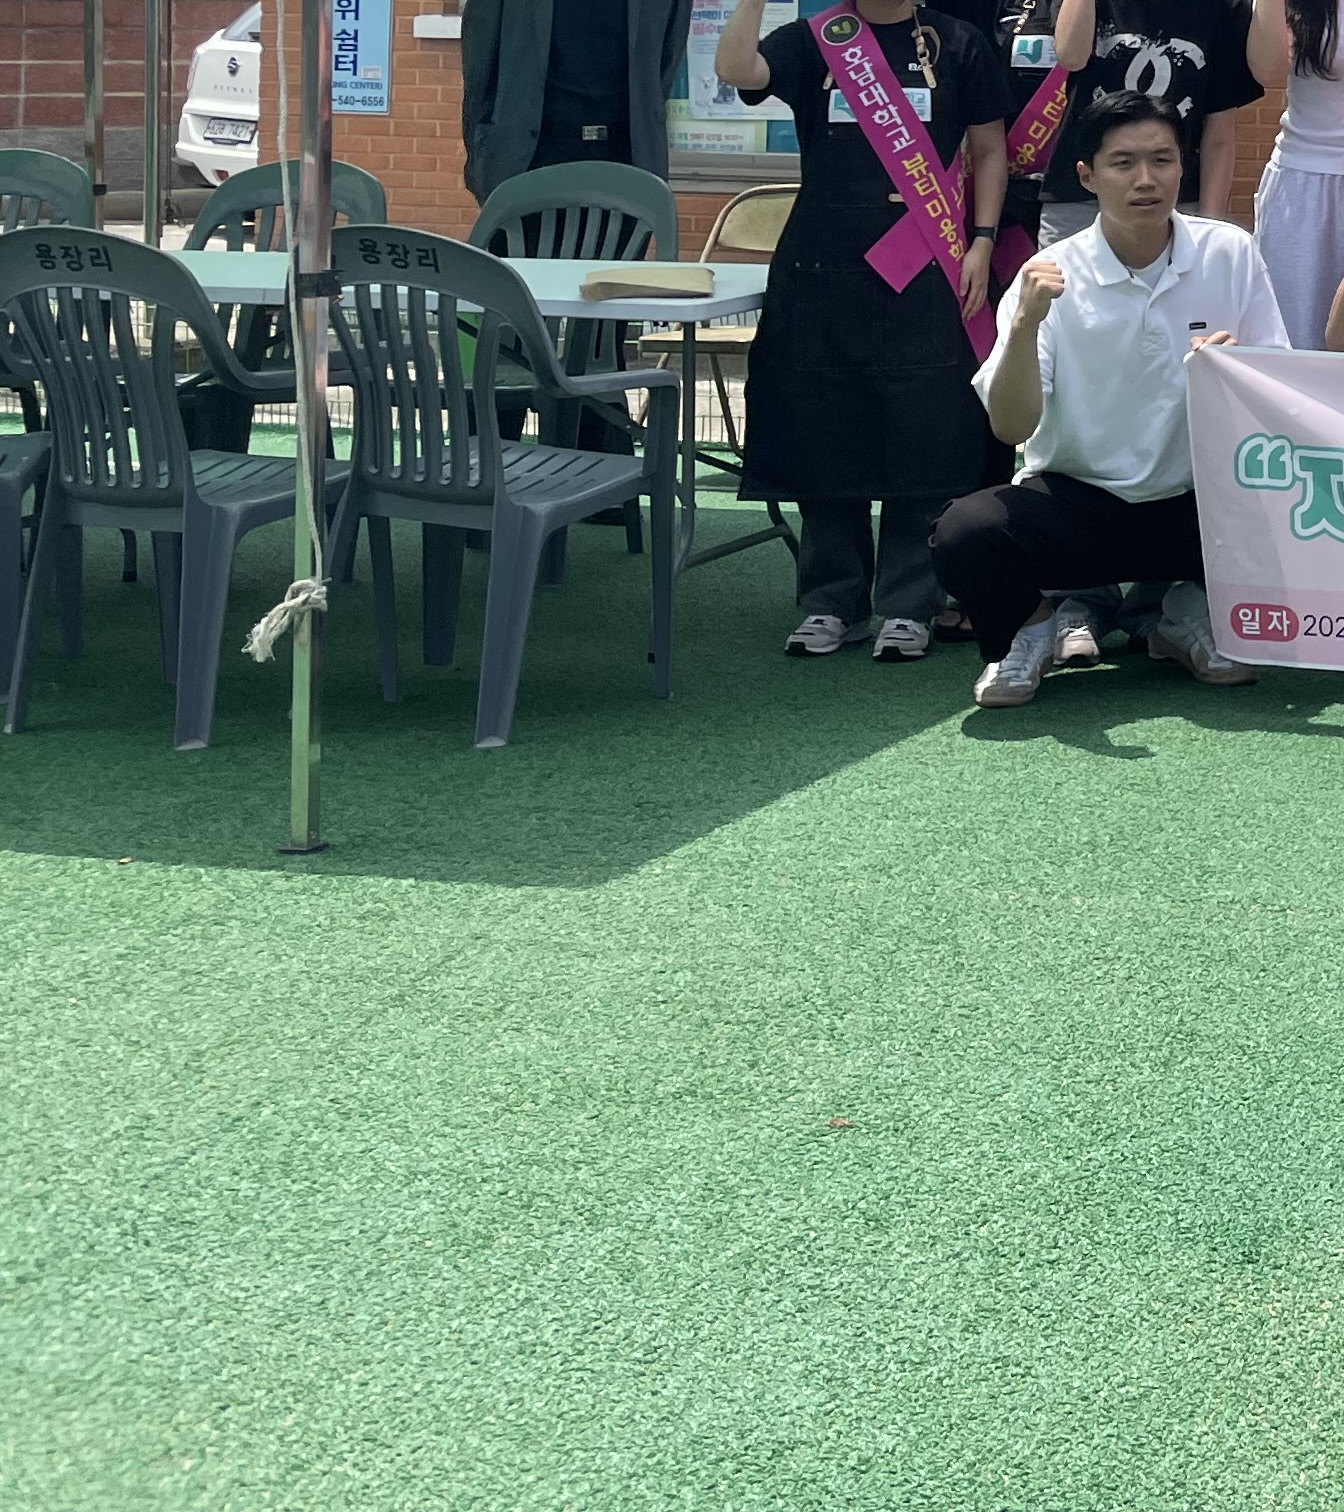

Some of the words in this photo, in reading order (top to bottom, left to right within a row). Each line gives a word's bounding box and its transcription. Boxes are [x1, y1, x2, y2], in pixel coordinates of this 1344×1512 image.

[333, 29, 359, 76] 쉼터
[841, 45, 916, 153] 호남대학교
[34, 242, 113, 272] 용장리
[358, 237, 441, 273] 용장리
